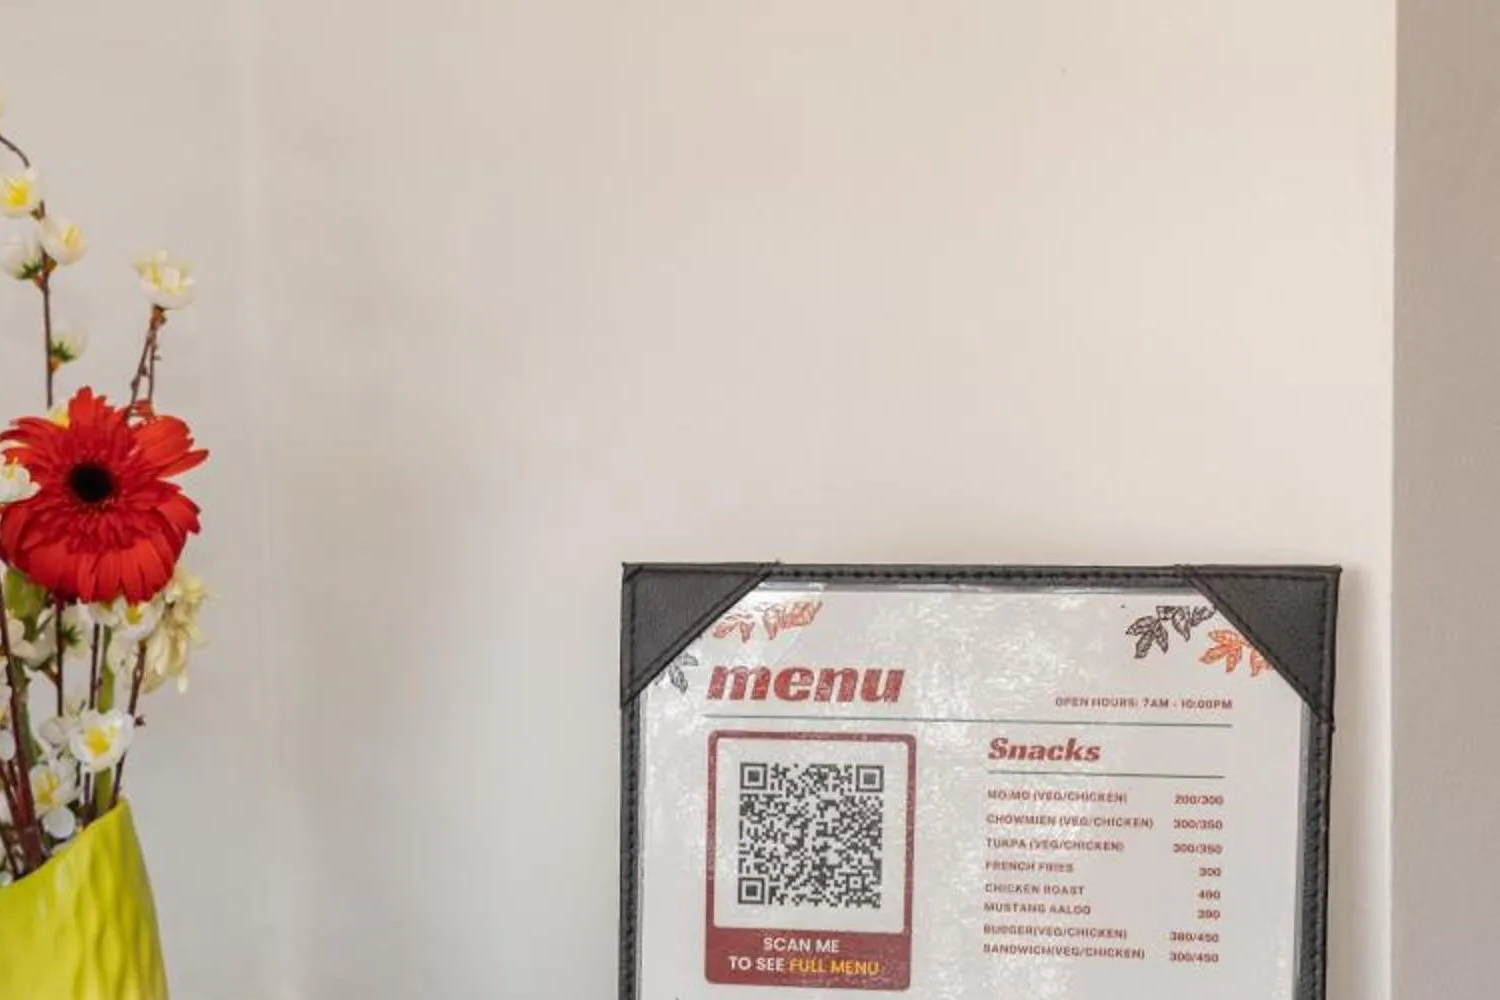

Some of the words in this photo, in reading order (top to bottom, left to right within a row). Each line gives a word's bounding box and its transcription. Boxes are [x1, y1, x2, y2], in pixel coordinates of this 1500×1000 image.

[707, 665, 905, 703] menu
[1055, 696, 1088, 707] OPEN
[1143, 697, 1169, 708] 7AM
[988, 737, 1101, 761] Snacks
[1059, 815, 1154, 829] (VEG/CHICKEN)
[1029, 839, 1125, 852] (VEG/CHICKEN)
[986, 861, 1035, 872] FRENCH
[1038, 863, 1074, 873] FRIES
[985, 883, 1039, 894] CHICKEN
[1043, 885, 1085, 895] ROAST
[984, 903, 1046, 914] MUSTANG
[763, 937, 810, 952] SCAN
[815, 939, 840, 953] ME
[729, 956, 751, 971] TO
[756, 956, 785, 972] SEE
[789, 958, 826, 973] FULL
[831, 959, 880, 976] MENU
